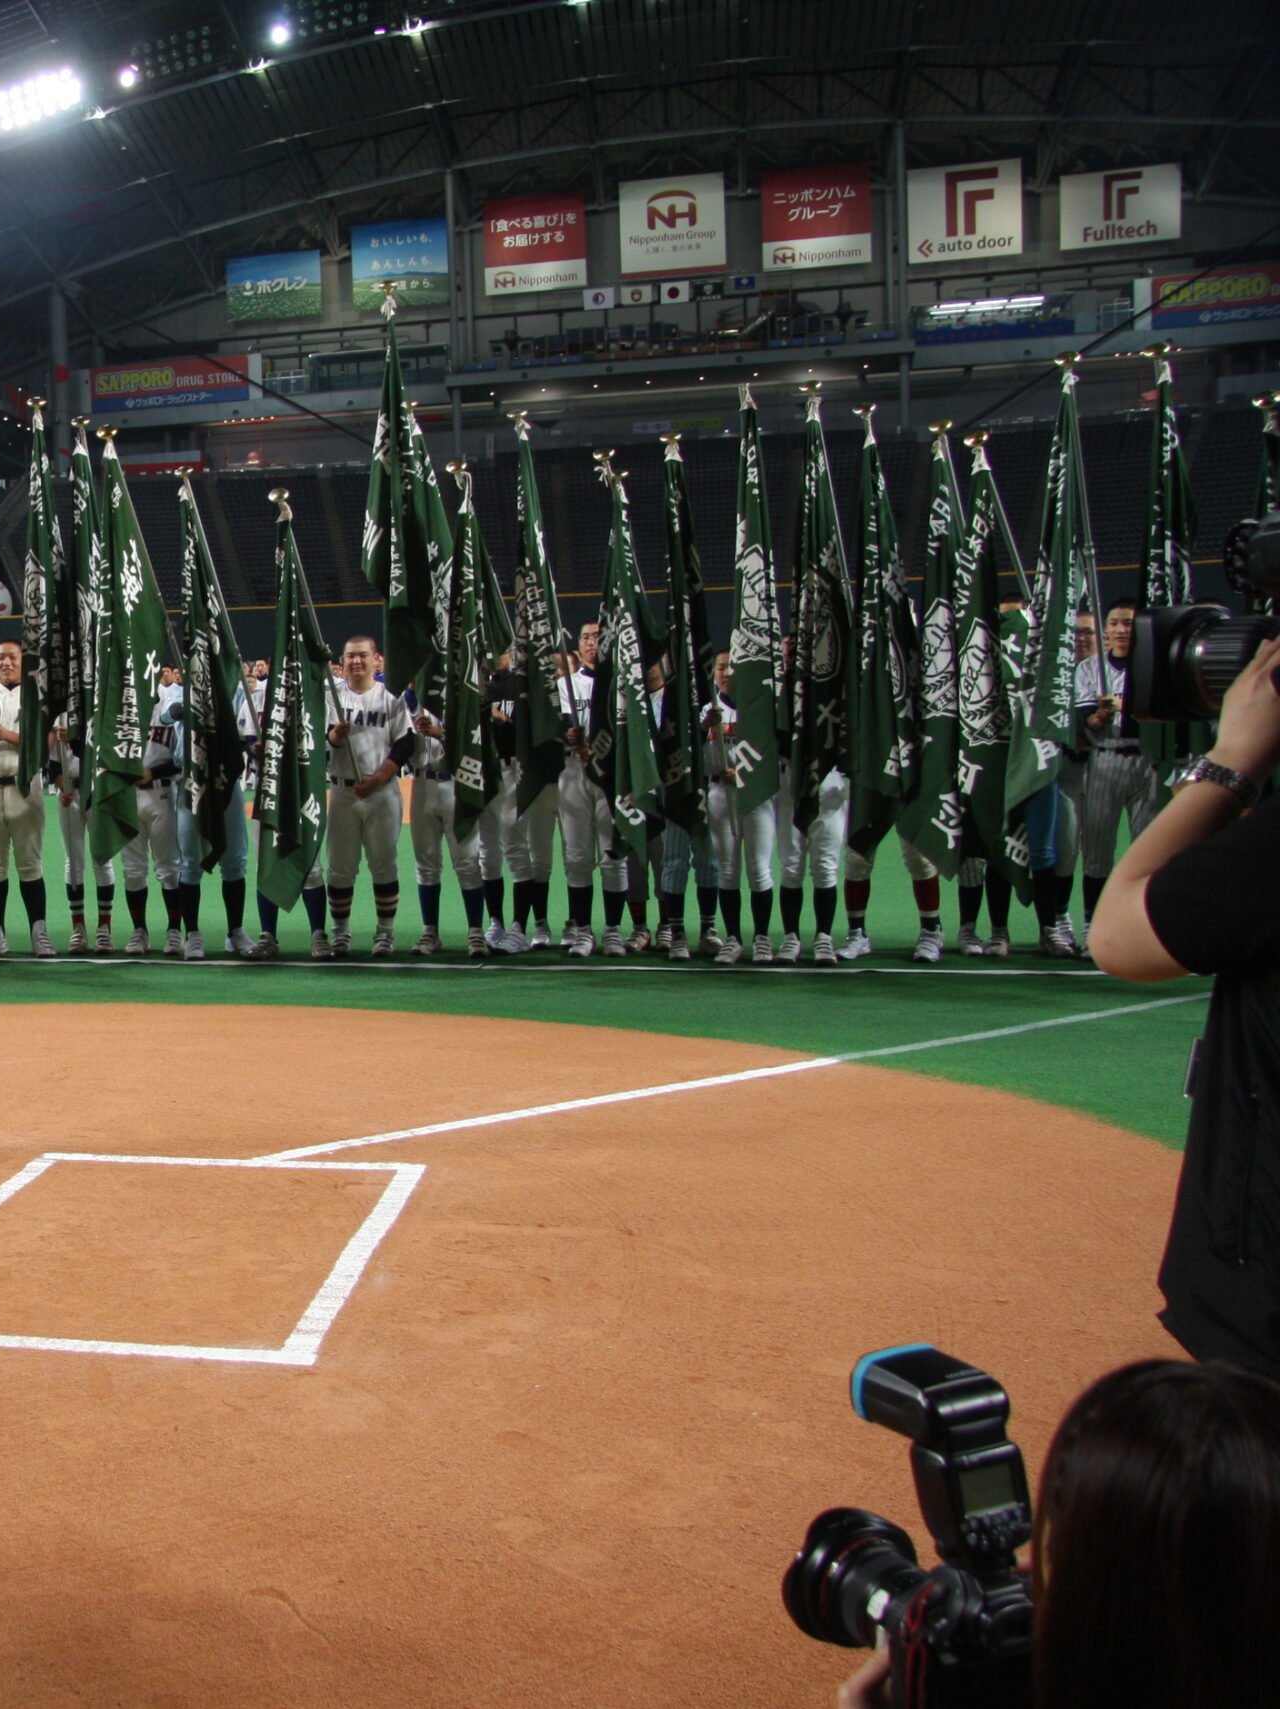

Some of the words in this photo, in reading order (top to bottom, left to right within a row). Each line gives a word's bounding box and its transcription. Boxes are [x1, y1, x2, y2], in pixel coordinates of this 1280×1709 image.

[773, 185, 856, 204] ニッポンハム
[788, 202, 843, 222] グループ
[503, 230, 565, 248] お届けする
[629, 232, 685, 246] Nipponham
[687, 229, 716, 241] Group
[1083, 220, 1158, 243] Fulltech
[937, 238, 973, 253] auto
[976, 235, 1013, 250] door
[799, 248, 862, 262] Nipponham
[256, 275, 308, 294] ホクレン
[518, 270, 578, 286] Nipponham
[1161, 275, 1267, 305] SAPPORO
[96, 368, 176, 394] SAPPORO
[176, 375, 204, 388] DRUG
[207, 371, 243, 385] STORE
